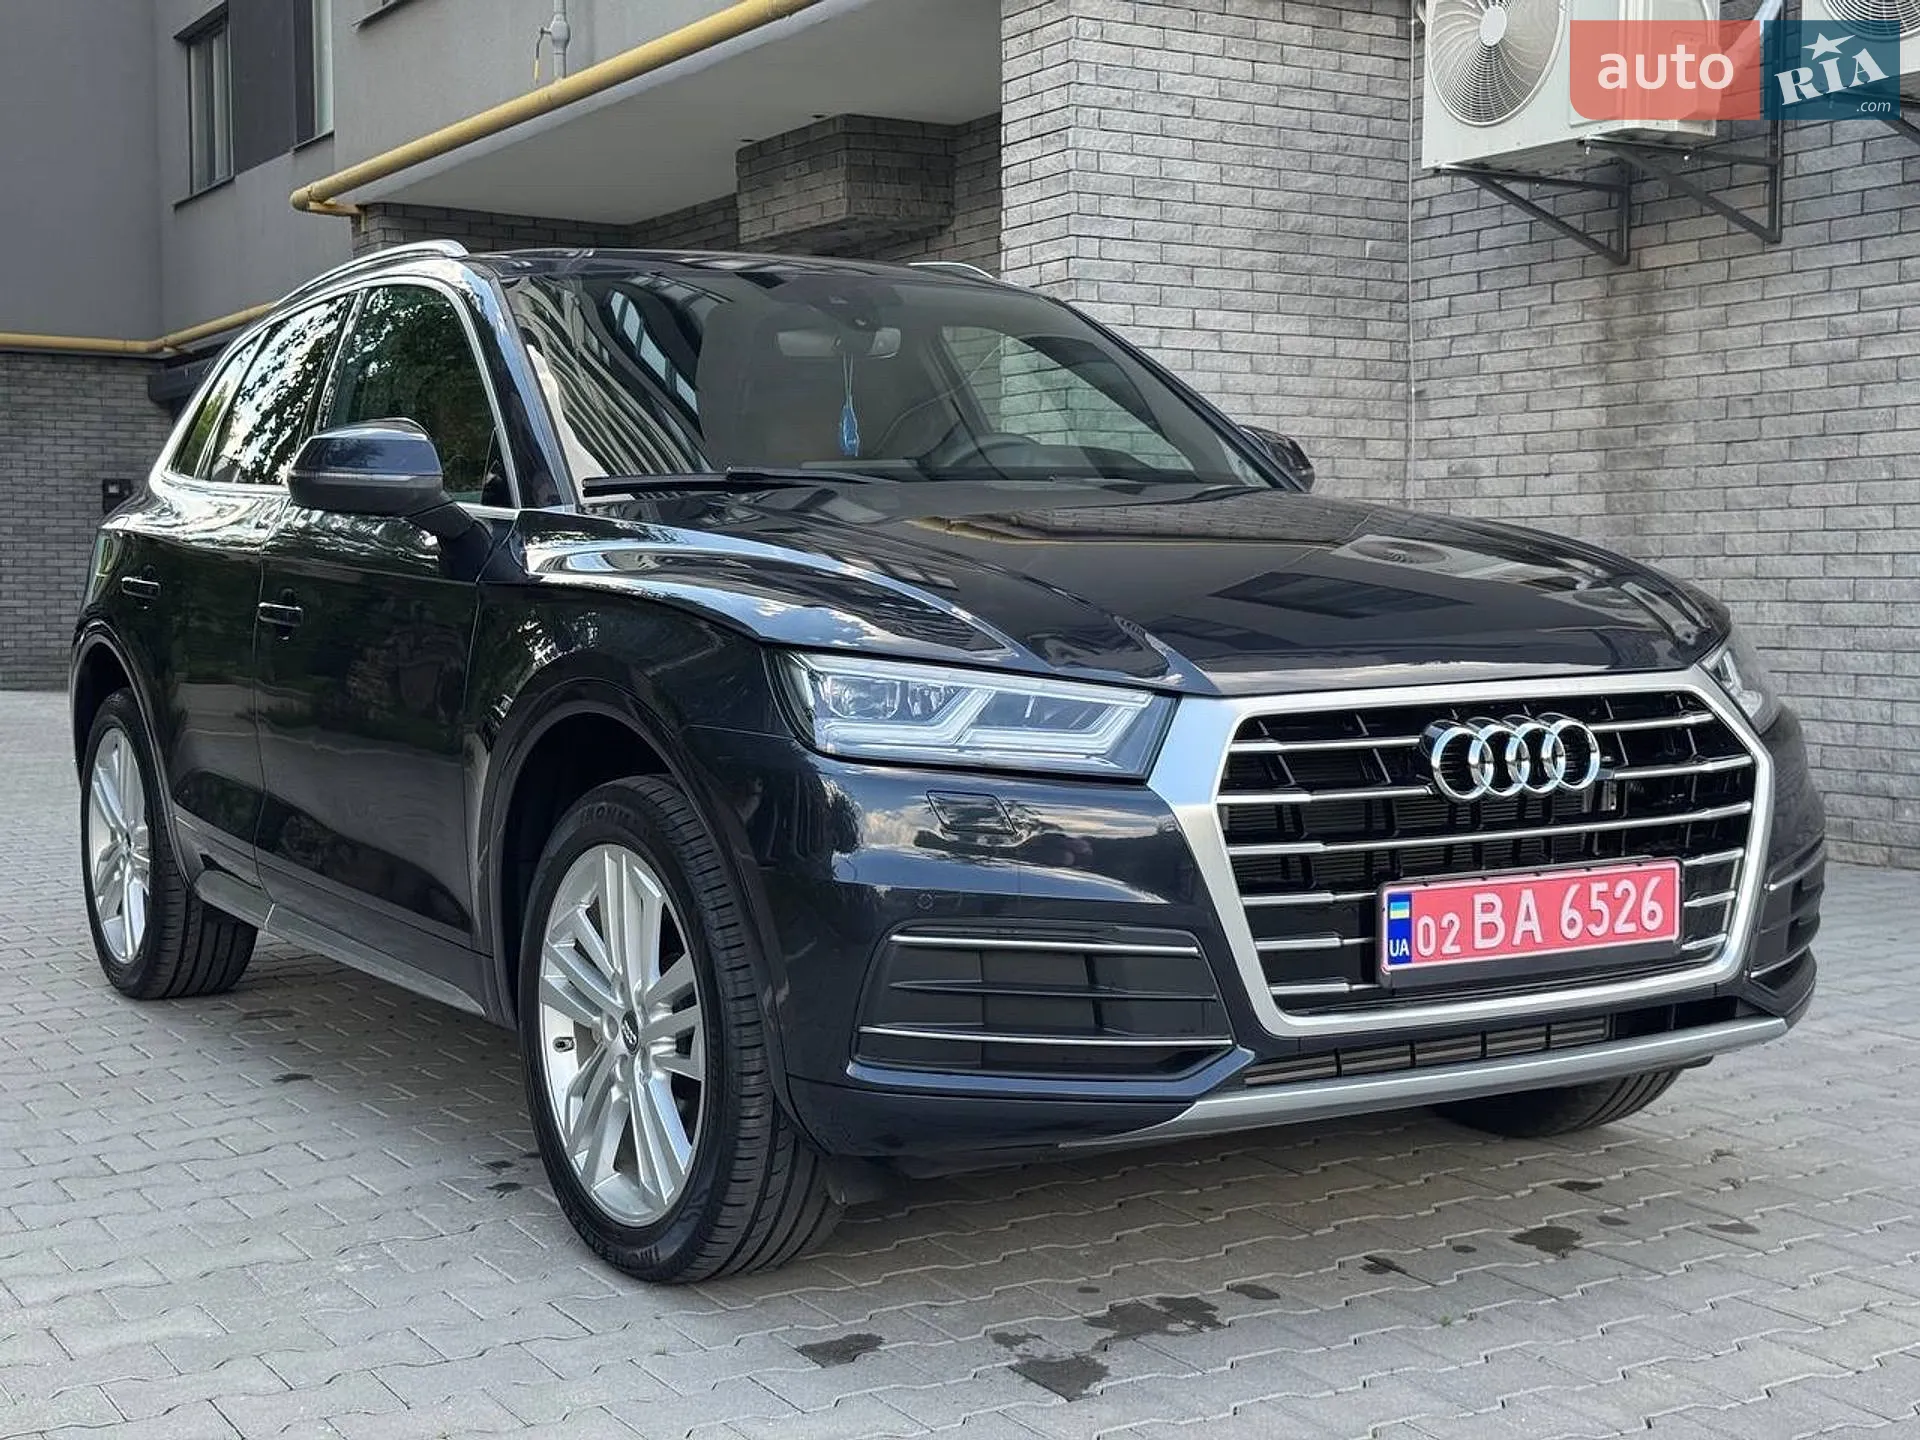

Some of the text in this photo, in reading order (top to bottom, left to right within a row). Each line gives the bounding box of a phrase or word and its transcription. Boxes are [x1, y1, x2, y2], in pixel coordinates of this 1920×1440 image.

[1416, 875, 1664, 957] 02 BA 6526
[1389, 938, 1410, 957] UA
